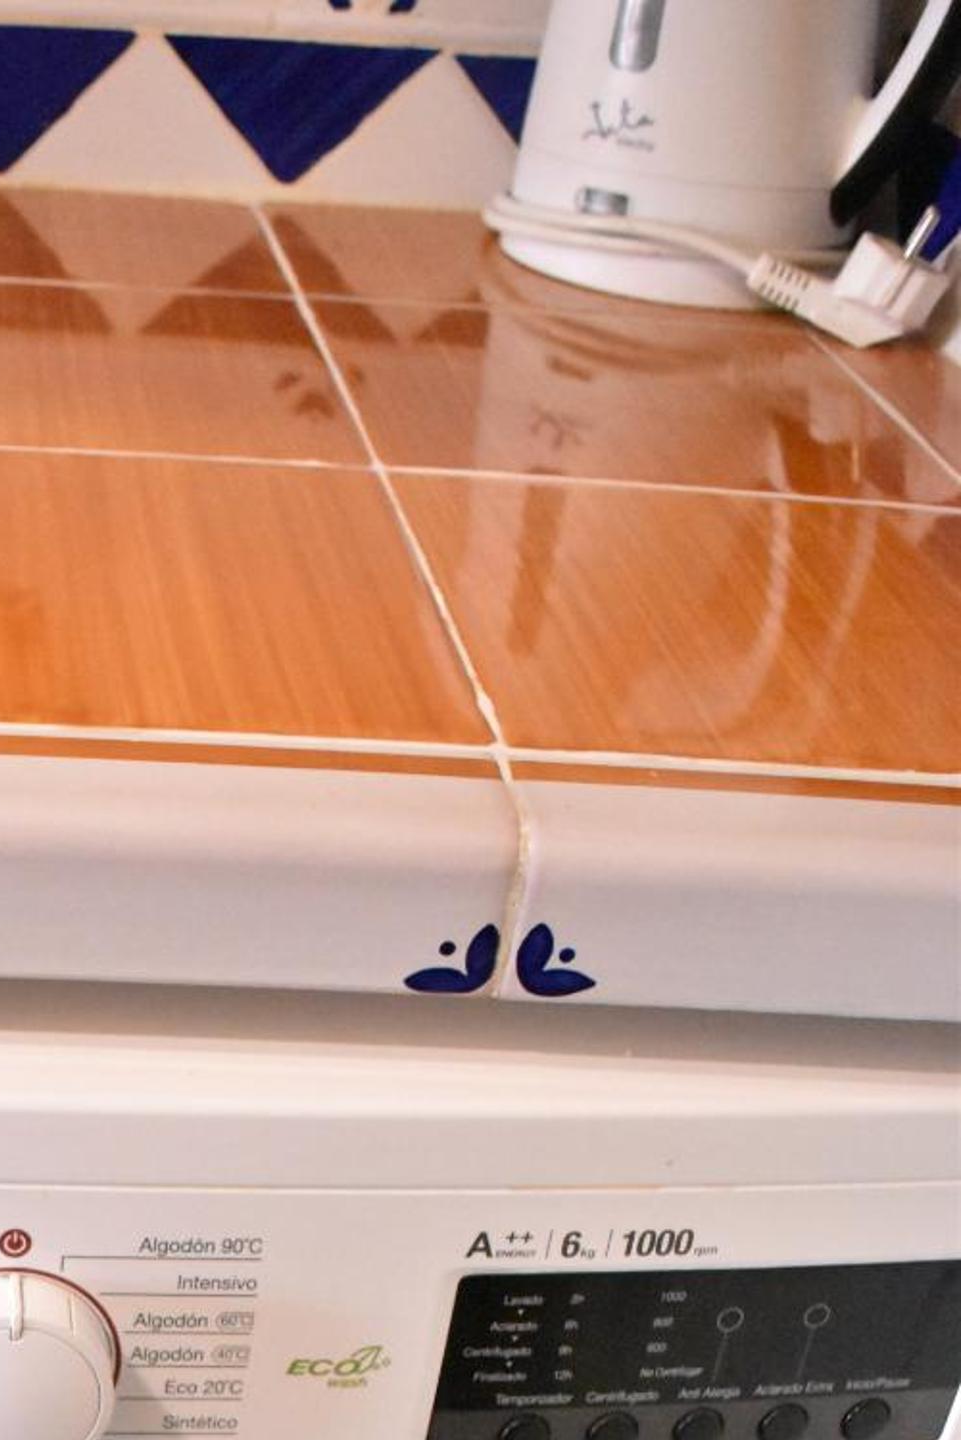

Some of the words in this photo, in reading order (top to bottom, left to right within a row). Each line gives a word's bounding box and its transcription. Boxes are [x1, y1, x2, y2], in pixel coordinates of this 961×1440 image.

[138, 1236, 216, 1258] Algodón
[176, 1274, 258, 1291] Intensivo
[132, 1311, 209, 1333] Algodón
[130, 1344, 205, 1365] Algodón
[285, 1358, 362, 1377] ECO
[163, 1378, 198, 1396] Eco
[160, 1413, 239, 1431] Sintético
